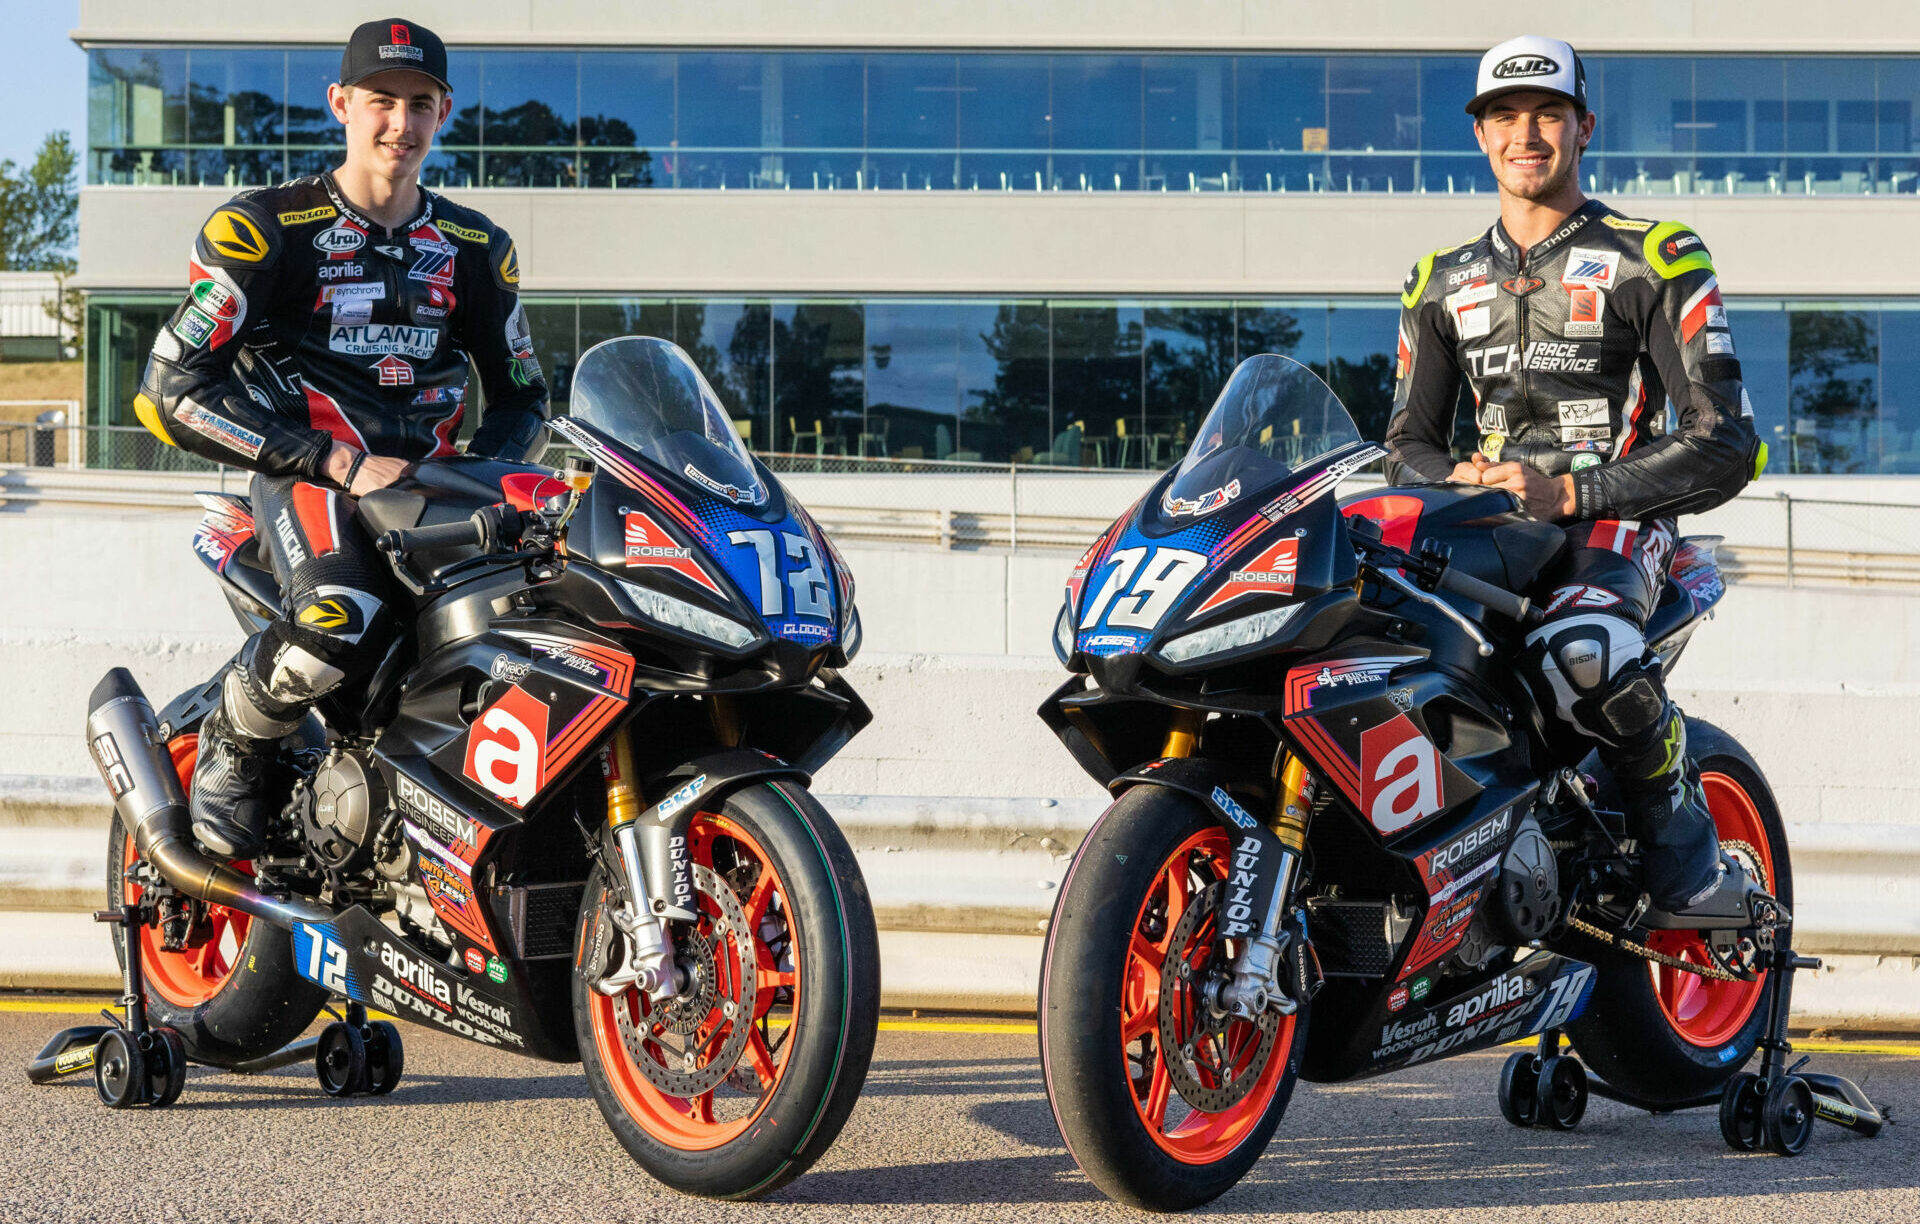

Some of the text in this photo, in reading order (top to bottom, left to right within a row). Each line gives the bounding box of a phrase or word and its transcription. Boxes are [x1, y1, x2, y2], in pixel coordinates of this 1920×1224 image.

[1500, 59, 1551, 76] HJC
[283, 208, 333, 224] DUNLOP
[319, 231, 360, 247] Arai
[440, 222, 486, 240] DUNLOP
[1541, 215, 1588, 248] THOR.1
[318, 262, 364, 281] aprilia
[1449, 262, 1488, 285] aprilia
[336, 286, 382, 297] synchrony
[416, 305, 448, 317] ROBEM
[331, 326, 437, 348] ATLANTIC
[345, 344, 399, 353] CRUISING
[1466, 341, 1537, 377] TCH
[1535, 342, 1580, 357] RACE
[1530, 358, 1598, 372] SERVICE
[1344, 447, 1379, 464] MILLENNIUM
[1262, 502, 1282, 516] TWINS
[1280, 494, 1293, 504] CUP
[628, 546, 689, 559] ROBEM
[727, 528, 832, 620] 72
[1231, 572, 1292, 584] ROBEM
[1079, 546, 1208, 630] 79
[1085, 635, 1137, 646] HOBBS
[558, 651, 595, 666] SPRINT
[562, 659, 600, 676] FILTER
[1568, 652, 1597, 666] BISON
[1331, 671, 1368, 683] SPRINT
[1347, 674, 1384, 685] FILTER
[474, 708, 539, 807] a
[1372, 735, 1439, 831] a
[659, 775, 706, 821] SKF
[1213, 787, 1256, 828] SKF
[401, 777, 474, 846] ROBEM
[1432, 811, 1509, 875] ROBEM
[669, 836, 692, 907] DUNLOP
[1455, 865, 1488, 888] MAGURA
[440, 881, 466, 904] LESS
[1223, 836, 1262, 936] DUNLOP
[1447, 905, 1472, 927] LESS
[302, 922, 348, 994] 72
[590, 923, 604, 971] brembo
[381, 941, 452, 1006] aprilia
[489, 962, 504, 973] NTK
[1297, 944, 1307, 992] brembo
[400, 978, 453, 1013] RACING
[1390, 990, 1406, 1002] NGK
[1413, 980, 1428, 992] NTK
[372, 974, 502, 1045] DUNLOP
[456, 982, 512, 1027] Vesrah
[1446, 974, 1524, 1027] aprilia
[1529, 967, 1592, 1034] 79
[1467, 1000, 1522, 1025] RACING
[456, 1005, 525, 1047] WOODCRAFT
[1381, 1012, 1439, 1046] Vesrah
[1404, 987, 1548, 1065] DUNLOP
[1372, 1026, 1441, 1060] WOODCRAFT
